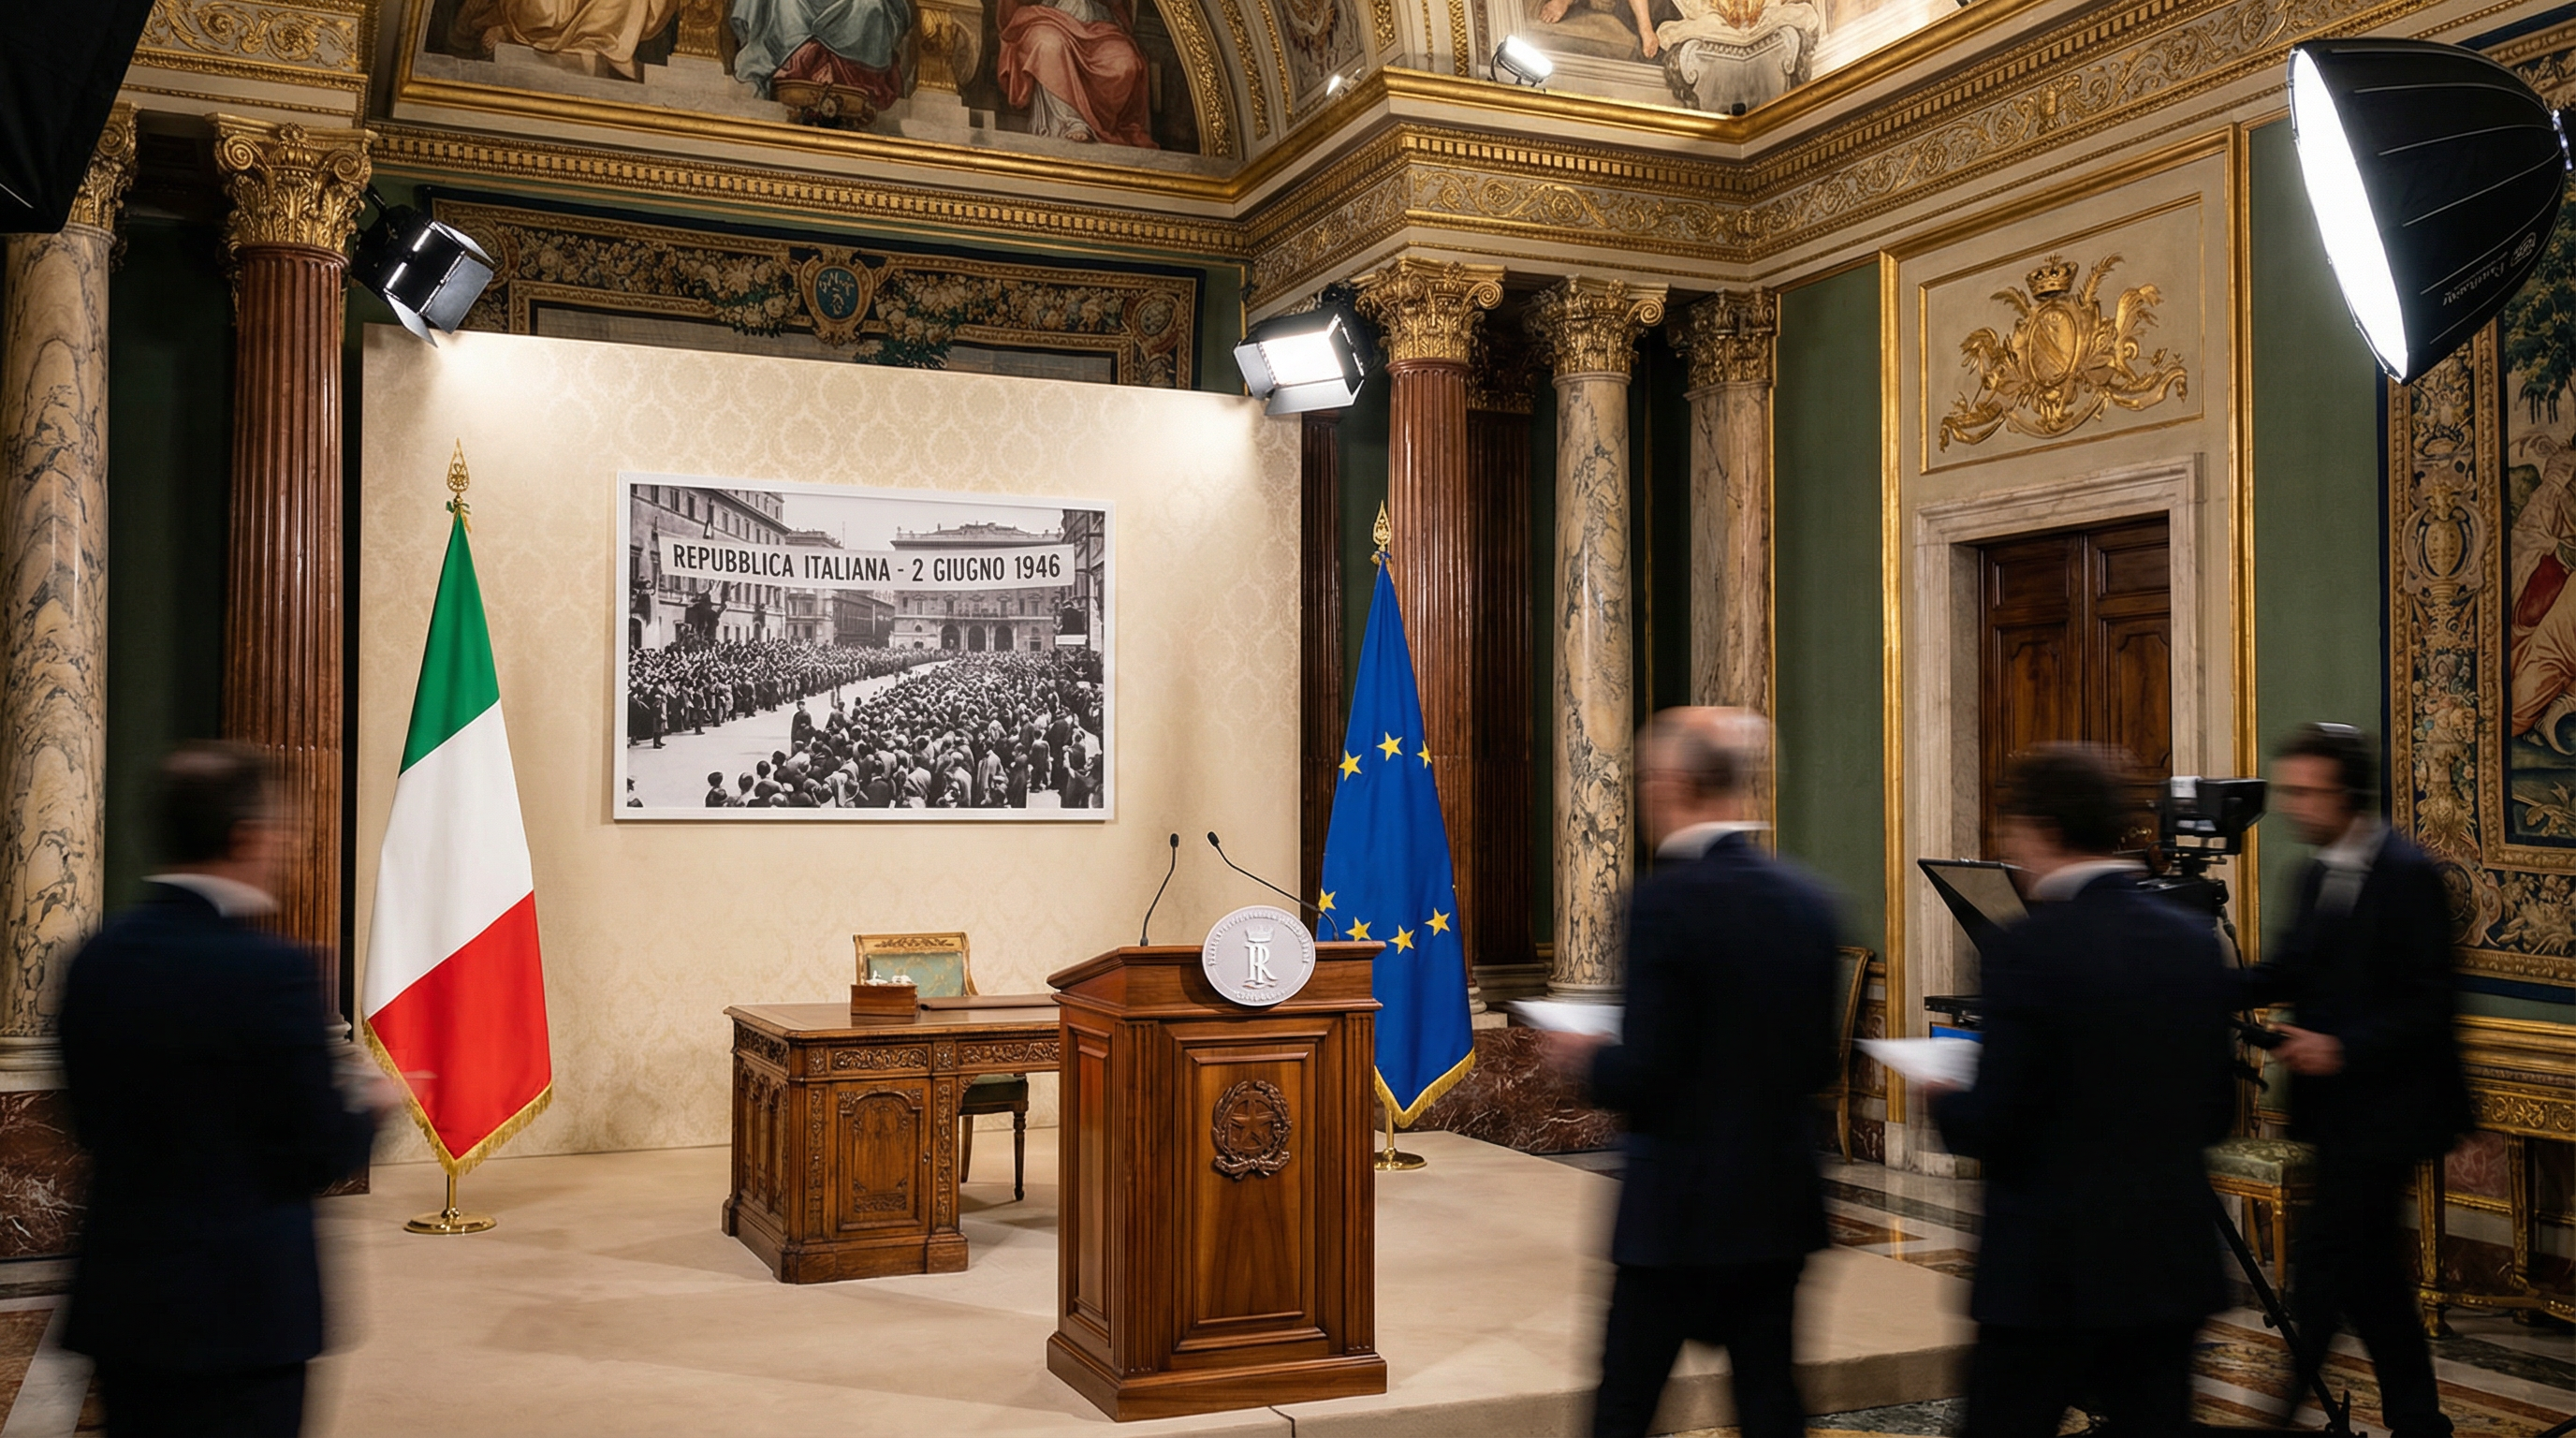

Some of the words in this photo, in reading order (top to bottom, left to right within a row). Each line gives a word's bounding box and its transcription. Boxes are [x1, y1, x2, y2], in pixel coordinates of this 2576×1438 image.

[673, 544, 795, 578] REPUBBLICA
[804, 555, 891, 581] ITALIANA
[912, 558, 924, 582] 2
[933, 556, 1005, 582] GIUGNO
[1014, 553, 1061, 580] 1946
